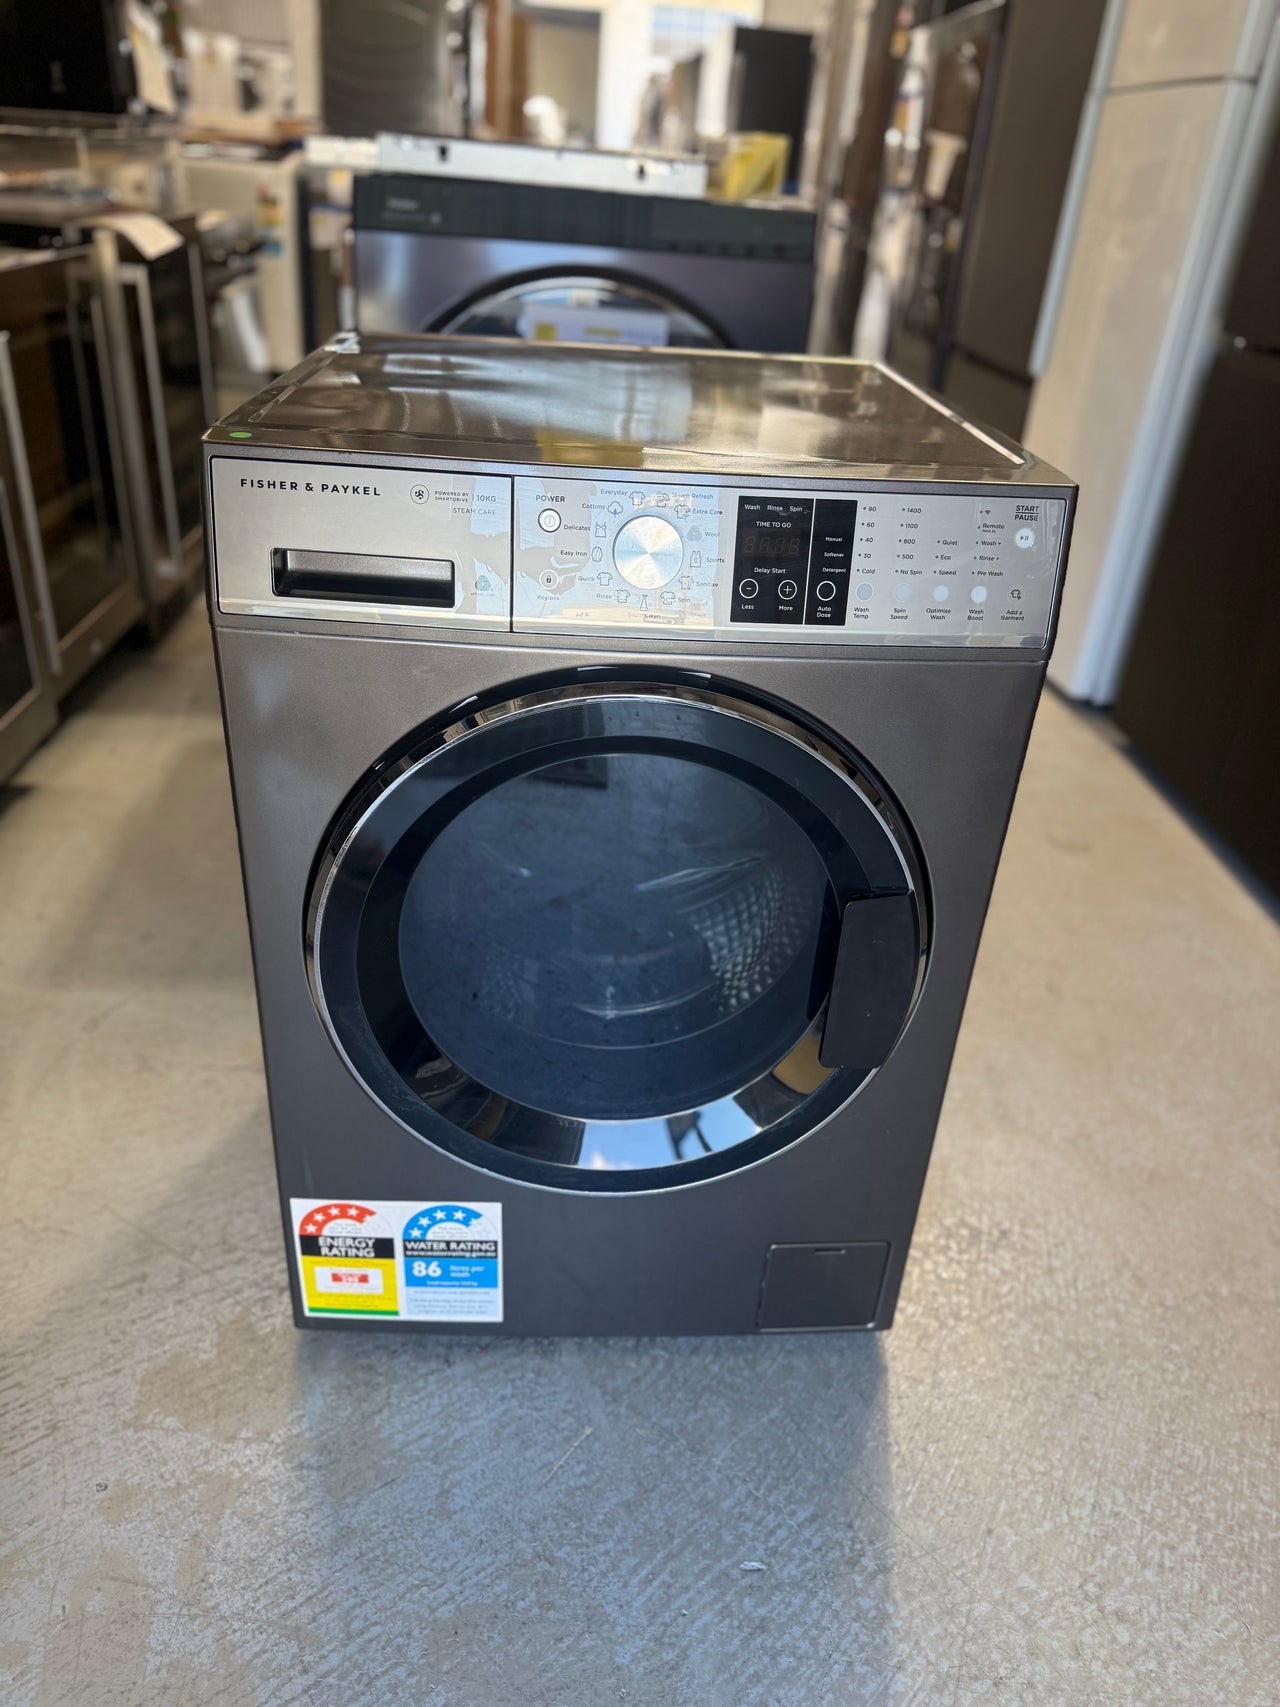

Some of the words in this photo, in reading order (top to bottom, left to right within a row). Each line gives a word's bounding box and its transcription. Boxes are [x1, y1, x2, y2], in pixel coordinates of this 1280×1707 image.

[240, 478, 298, 491] FISHER
[305, 482, 314, 492] &
[321, 483, 381, 496] PAYKEL
[600, 488, 628, 497] Everyday
[476, 494, 497, 502] 10KG
[535, 494, 566, 503] POWER
[581, 502, 606, 510] Cottons
[477, 508, 497, 516] CARE
[1014, 514, 1039, 522] PAUSE
[563, 524, 591, 532] Delicates
[560, 549, 574, 558] Easy
[754, 567, 771, 575] Delay
[938, 569, 957, 577] Speed
[577, 574, 595, 583] Quick
[596, 592, 612, 600] Rinse
[677, 596, 691, 604] Spin
[893, 607, 907, 615] Spin
[926, 607, 952, 615] Optimise
[318, 1236, 376, 1248] ENERGY
[404, 1241, 448, 1250] WATER
[449, 1242, 496, 1251] RATING
[320, 1246, 376, 1258] RATING
[412, 1260, 442, 1278] 86
[471, 1265, 485, 1273] per
